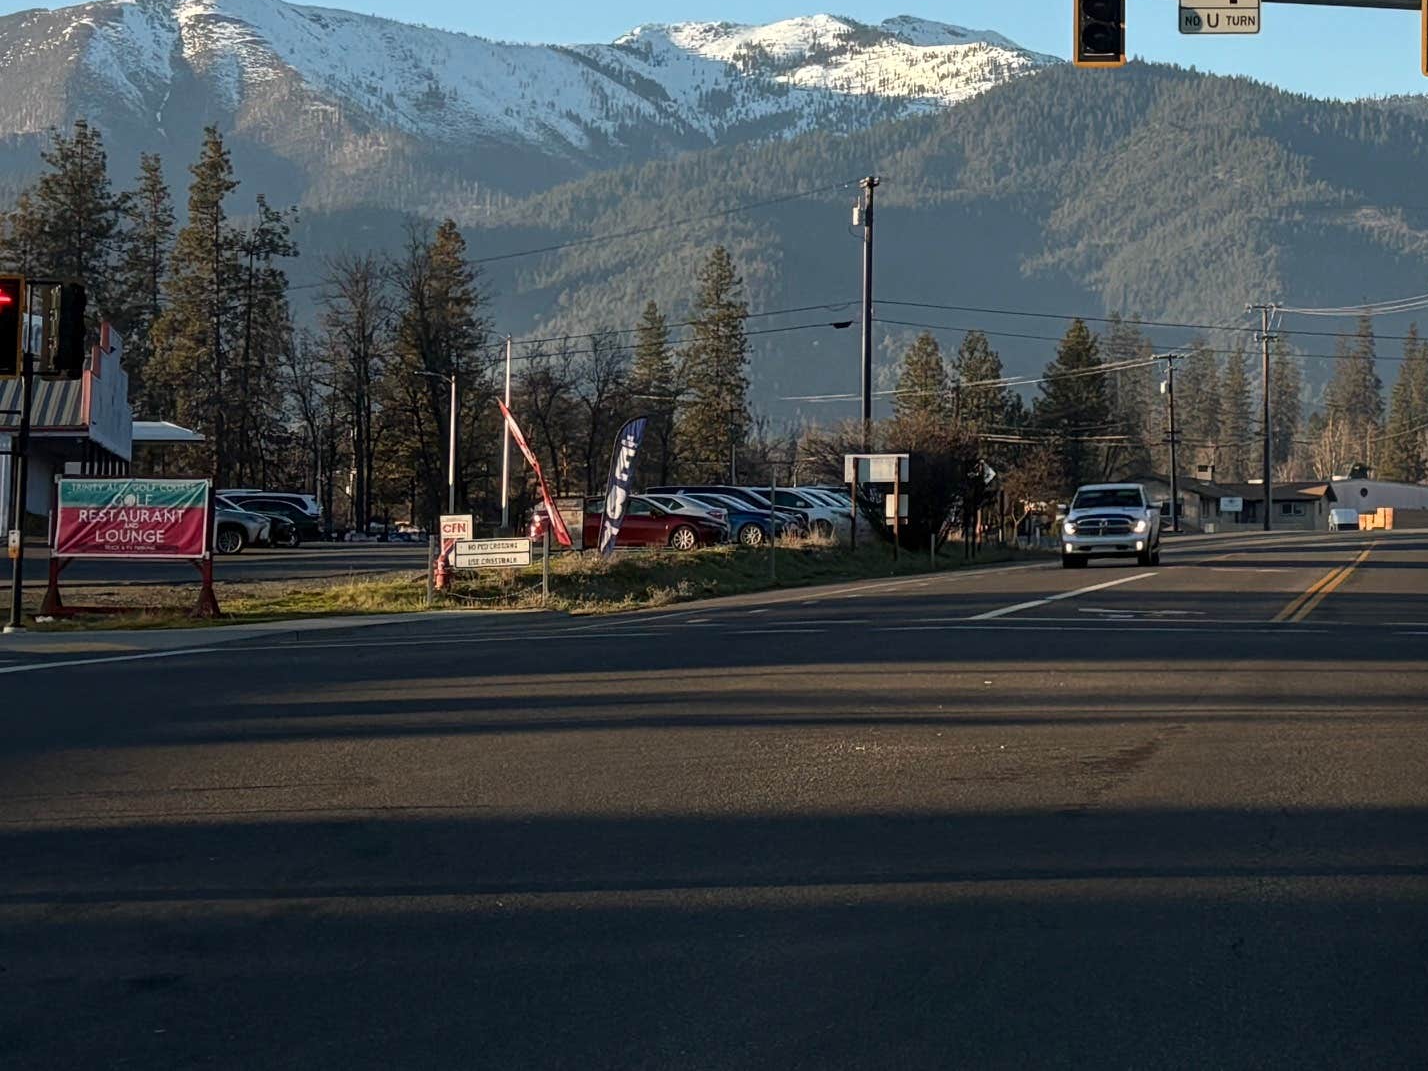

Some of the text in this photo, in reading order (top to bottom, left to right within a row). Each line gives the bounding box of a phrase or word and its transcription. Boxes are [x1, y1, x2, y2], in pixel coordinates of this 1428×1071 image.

[1184, 13, 1256, 28] NO U TURN
[72, 483, 103, 492] TRINITY
[133, 483, 155, 492] GOLF
[112, 494, 153, 507] GOLF
[78, 509, 186, 523] RESTAURANT
[442, 522, 466, 533] CFN
[95, 529, 165, 543] LOUNGE
